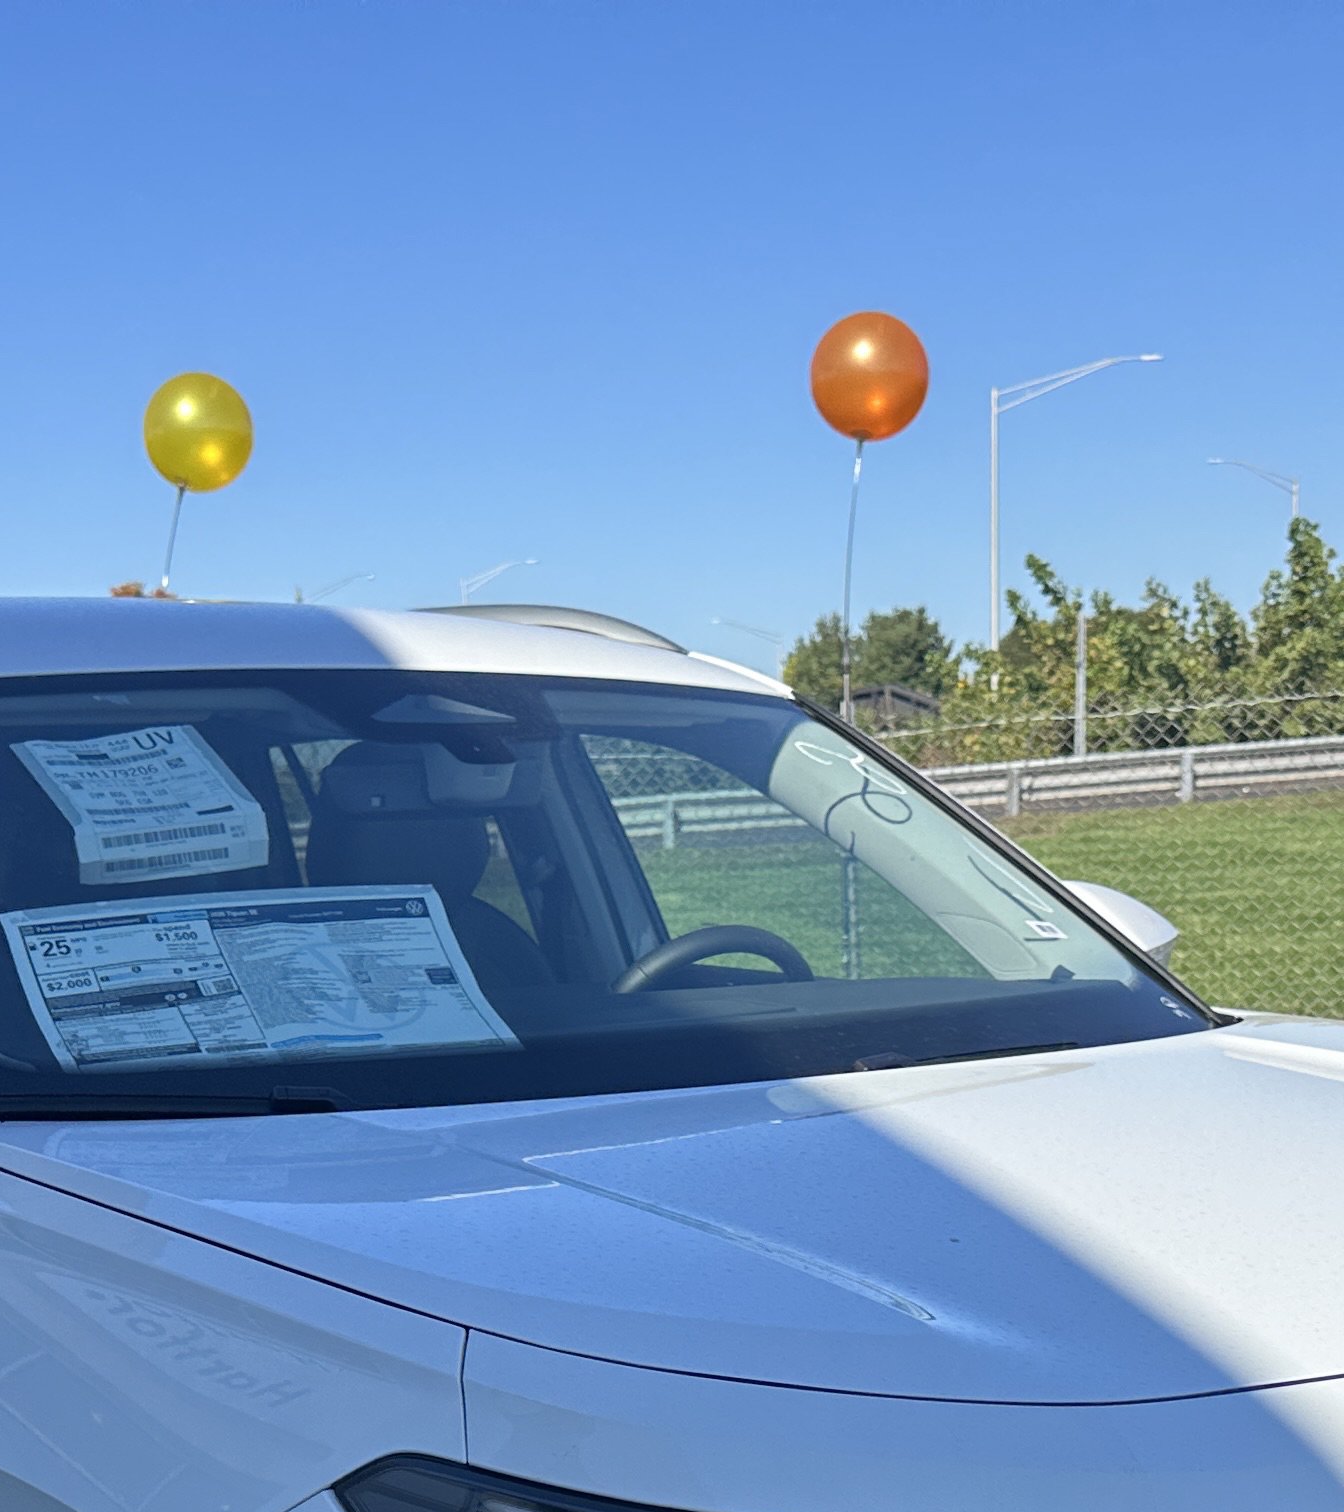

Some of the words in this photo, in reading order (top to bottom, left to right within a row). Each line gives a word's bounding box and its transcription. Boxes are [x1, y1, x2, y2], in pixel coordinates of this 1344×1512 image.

[133, 731, 174, 750] UV
[156, 931, 197, 943] $1,500
[40, 940, 71, 957] 25
[46, 978, 92, 993] $2,000
